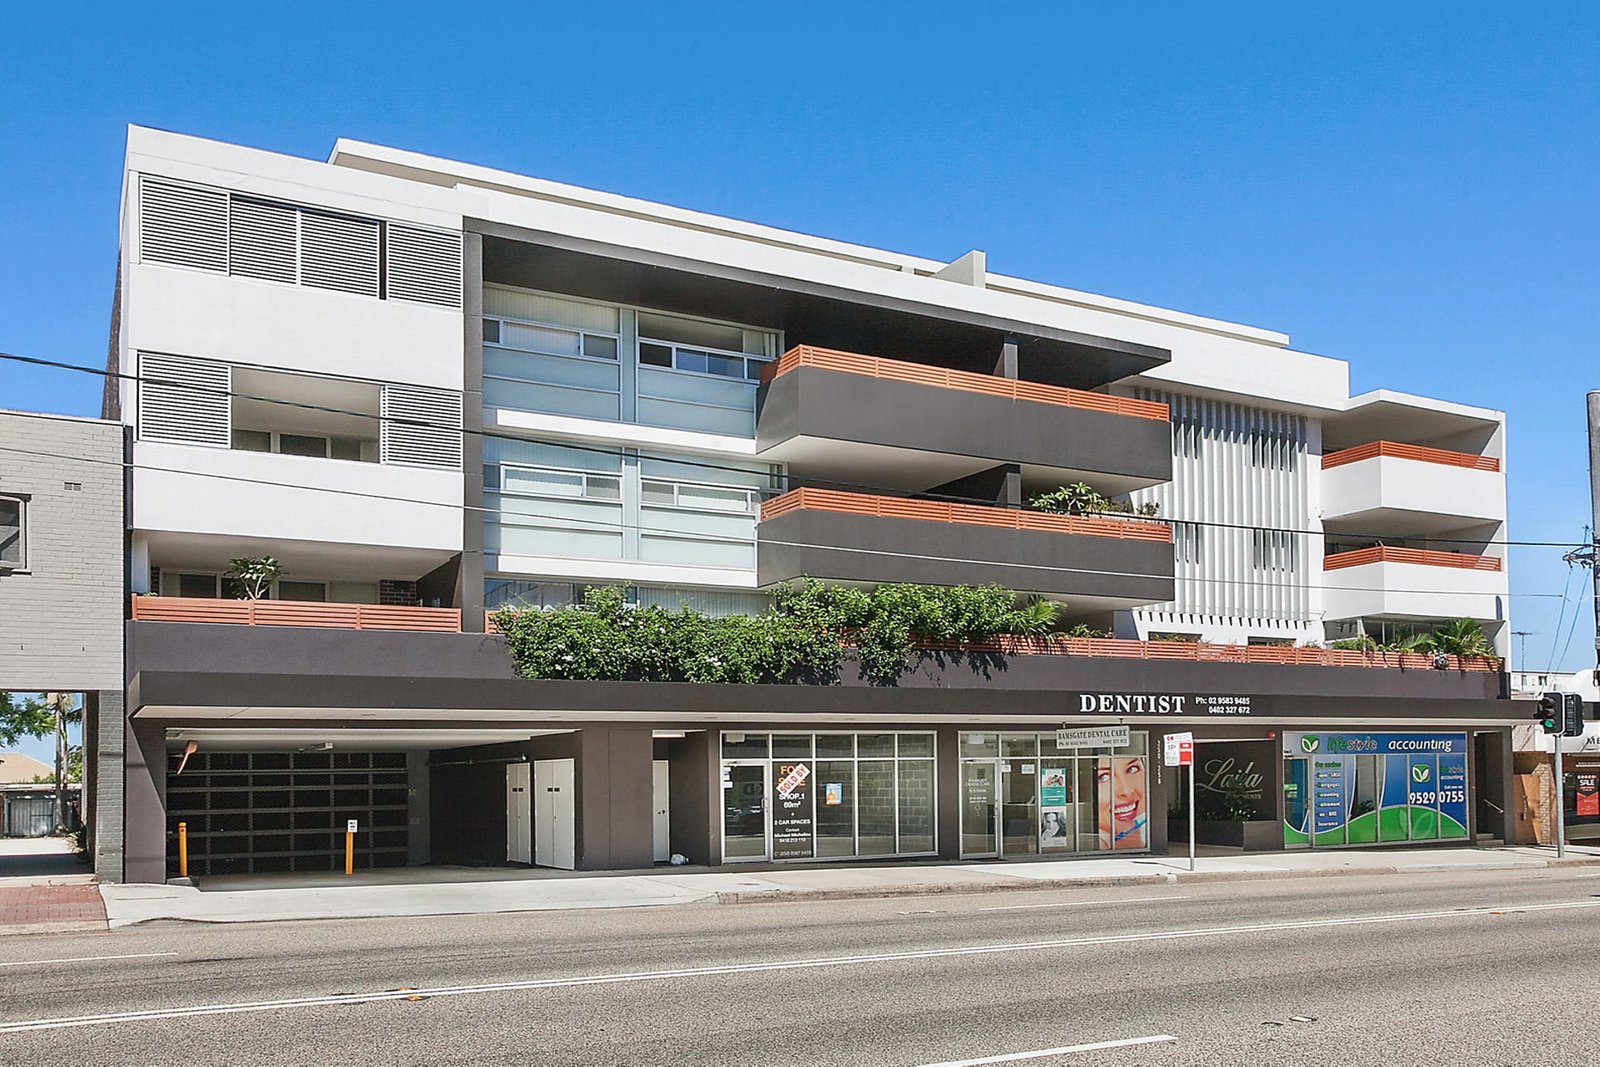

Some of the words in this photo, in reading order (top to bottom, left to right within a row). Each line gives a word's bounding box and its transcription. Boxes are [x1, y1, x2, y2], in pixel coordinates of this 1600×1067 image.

[1080, 694, 1185, 713] DENTIST
[1195, 696, 1207, 704] Ph:
[1058, 731, 1087, 740] RAMSGATE
[1088, 730, 1110, 738] DENTAL
[1111, 729, 1127, 737] CARE
[1327, 736, 1377, 753] lifestyle
[1388, 738, 1452, 752] accounting
[780, 775, 798, 793] SOLD
[795, 766, 806, 777] BY
[1409, 792, 1436, 804] 9529
[1439, 791, 1464, 803] 0755
